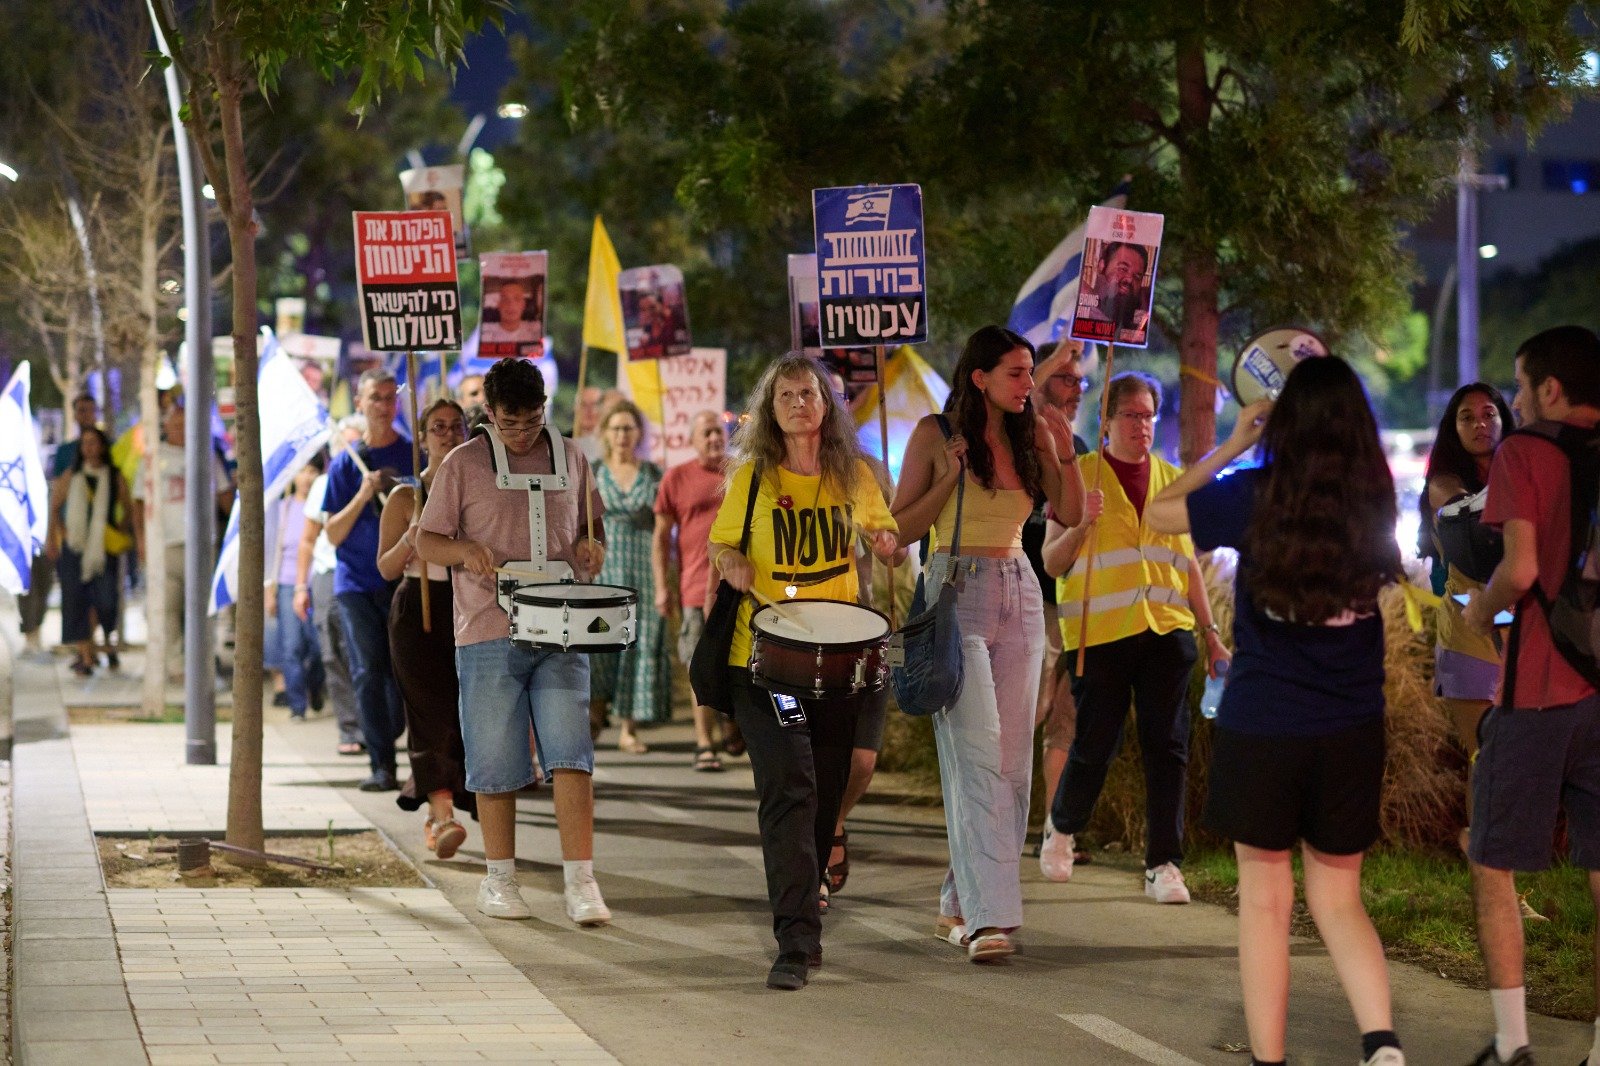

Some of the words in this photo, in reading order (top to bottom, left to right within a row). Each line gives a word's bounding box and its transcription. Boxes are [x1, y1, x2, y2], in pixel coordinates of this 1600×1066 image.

[365, 219, 388, 241] את
[390, 218, 446, 242] הפקרת
[364, 243, 451, 278] הביטחון
[821, 267, 922, 295] בחירות
[367, 289, 428, 313] להישאר
[431, 290, 456, 311] כדי
[1079, 293, 1099, 307] BRING
[373, 314, 456, 348] בשלטון
[826, 301, 920, 338] עכשיו!
[772, 504, 853, 567] NOW
